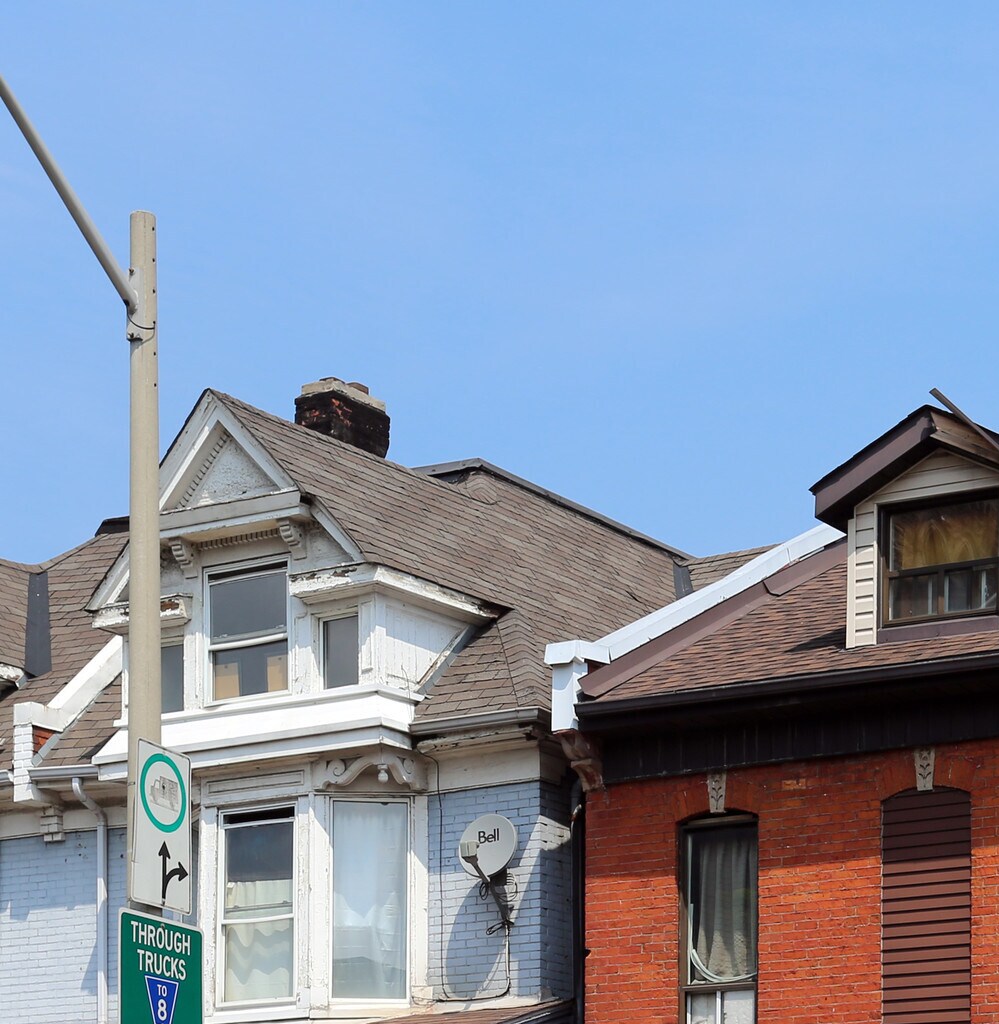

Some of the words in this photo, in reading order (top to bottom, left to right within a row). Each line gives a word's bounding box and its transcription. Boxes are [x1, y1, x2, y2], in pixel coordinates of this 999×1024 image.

[478, 828, 500, 844] Bell
[130, 920, 191, 956] THROUGH
[137, 949, 187, 981] TRUCKS
[157, 984, 168, 997] TO
[157, 999, 168, 1021] 8
